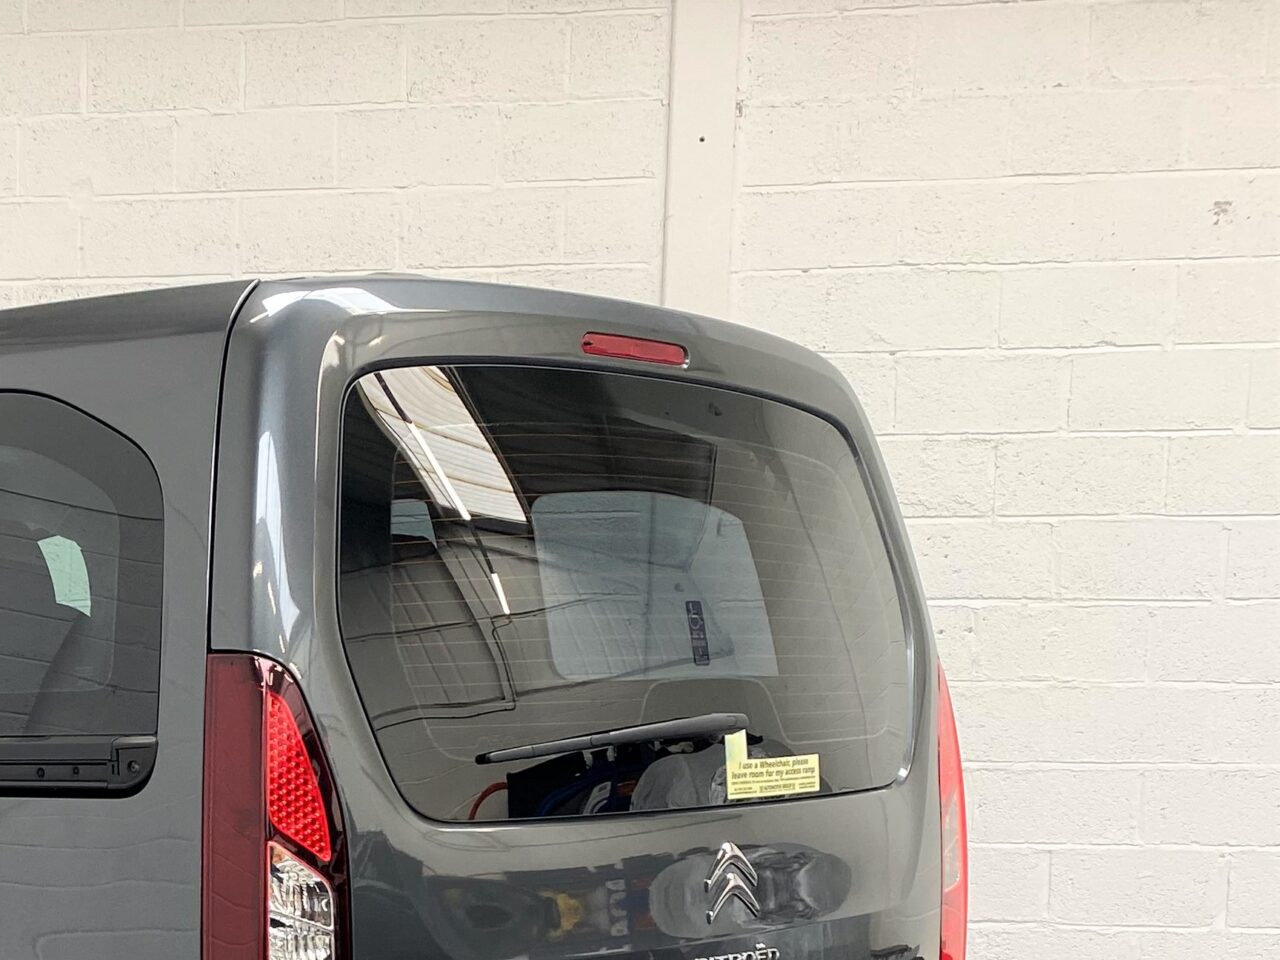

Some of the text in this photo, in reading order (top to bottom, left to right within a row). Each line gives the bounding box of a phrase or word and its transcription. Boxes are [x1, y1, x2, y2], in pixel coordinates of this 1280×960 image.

[742, 762, 753, 770] use
[792, 758, 809, 767] please
[731, 771, 748, 780] leave
[775, 769, 785, 778] my
